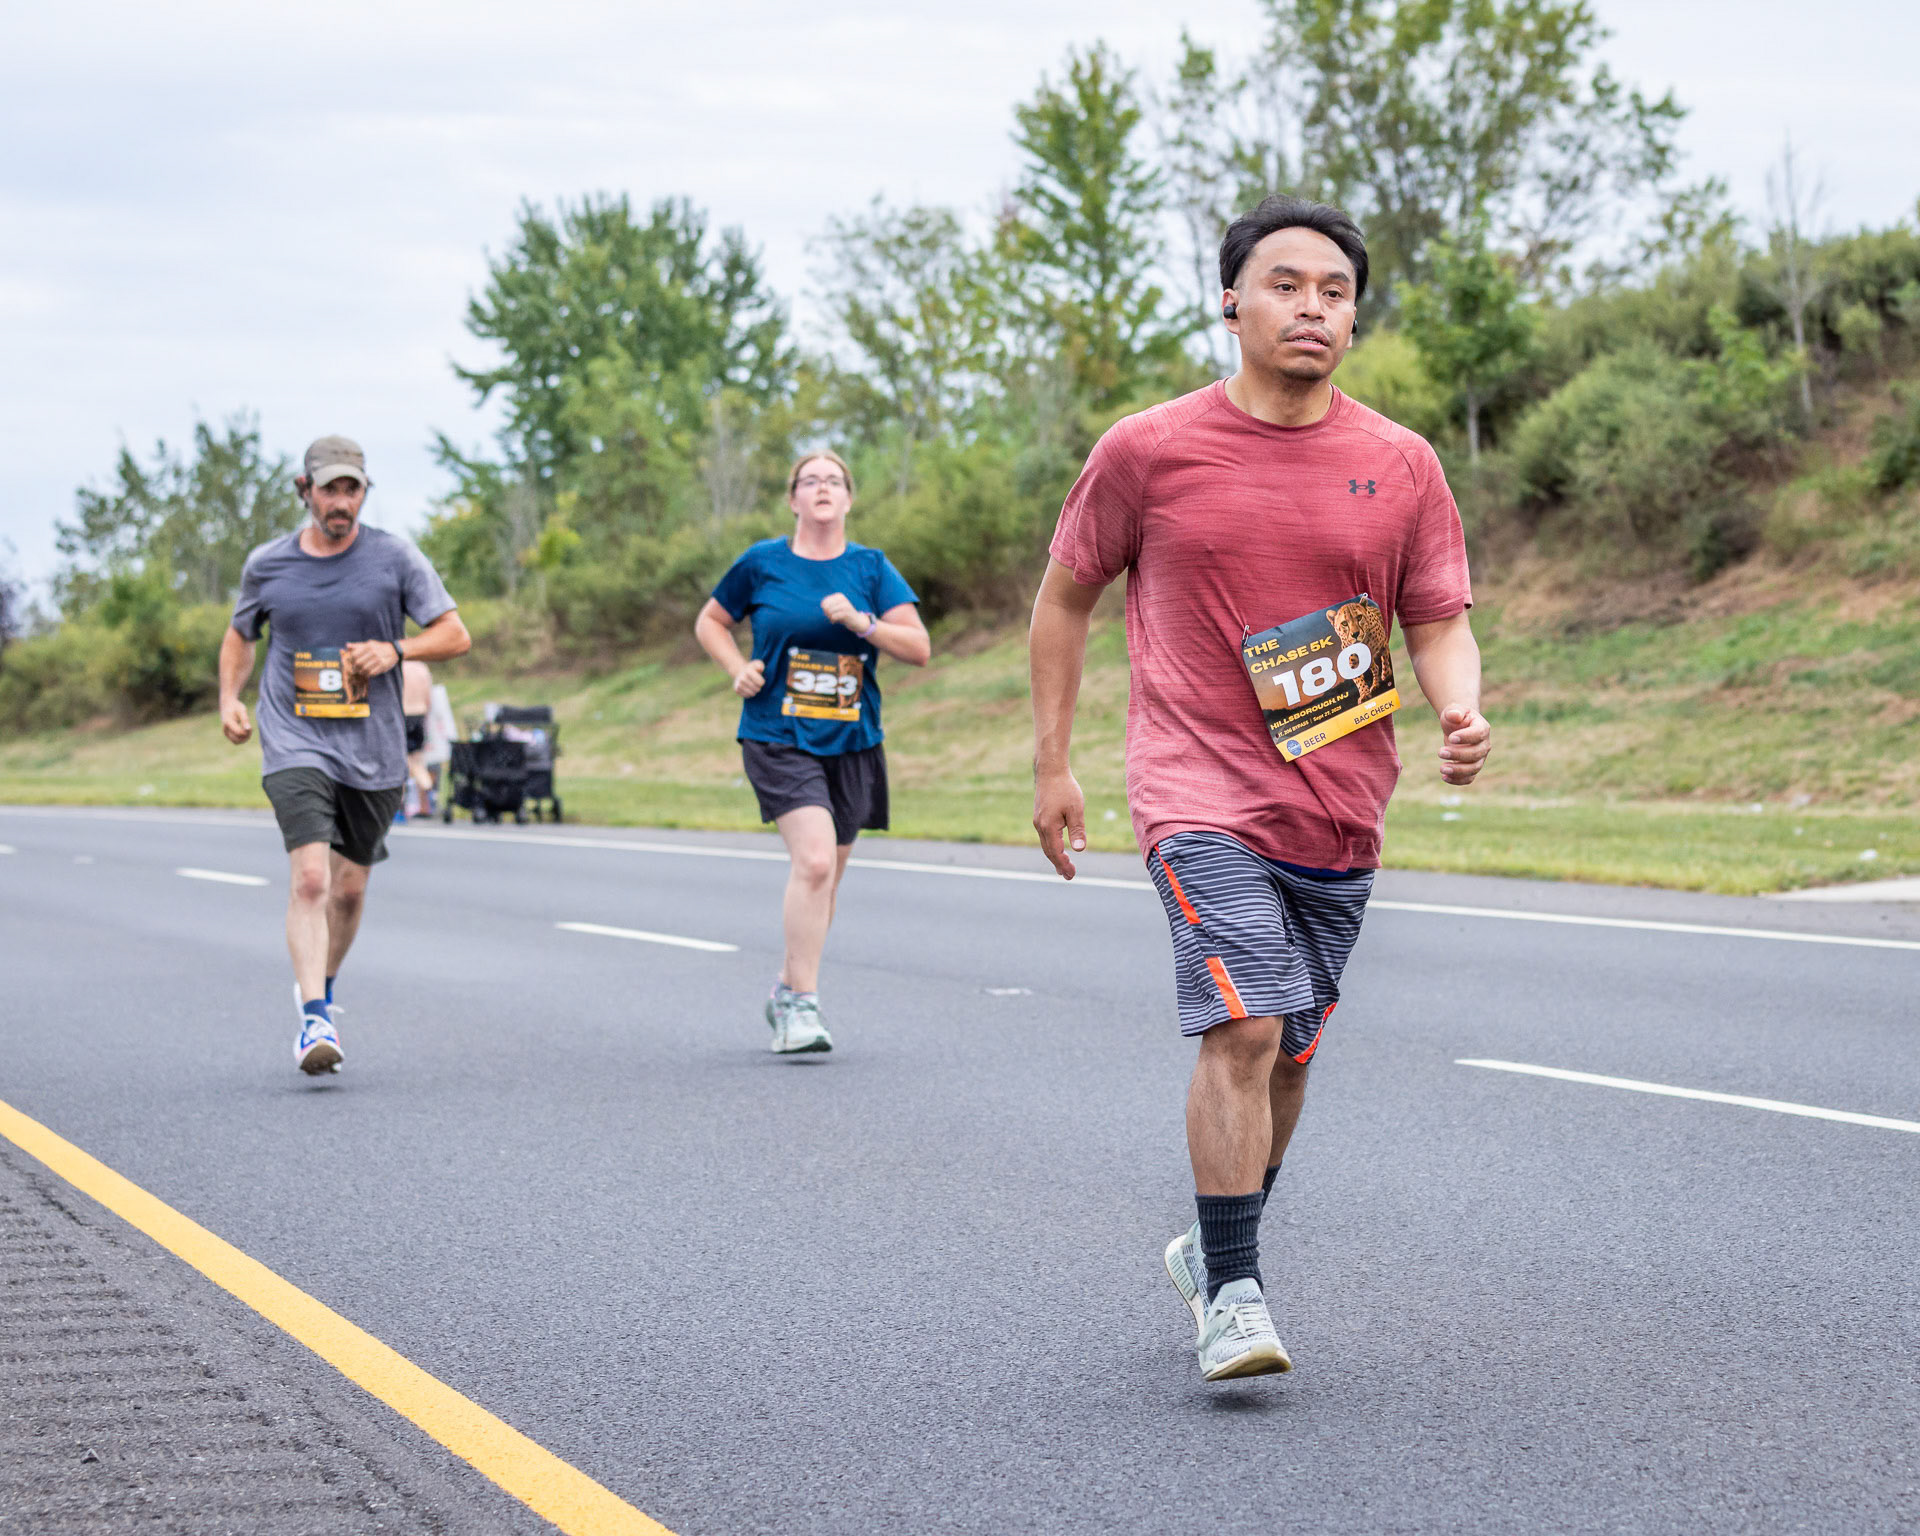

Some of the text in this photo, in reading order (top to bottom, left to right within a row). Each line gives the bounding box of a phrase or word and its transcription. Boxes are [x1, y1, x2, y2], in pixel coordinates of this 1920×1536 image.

[1244, 638, 1280, 658] THE
[1250, 635, 1335, 674] CHASE 5K
[318, 669, 343, 692] 8
[792, 670, 858, 696] 323
[1272, 642, 1372, 706] 180
[1336, 691, 1349, 701] NJ
[1312, 713, 1324, 722] Sept
[1353, 701, 1395, 725] BAG CHECK
[1303, 732, 1327, 748] BEER
